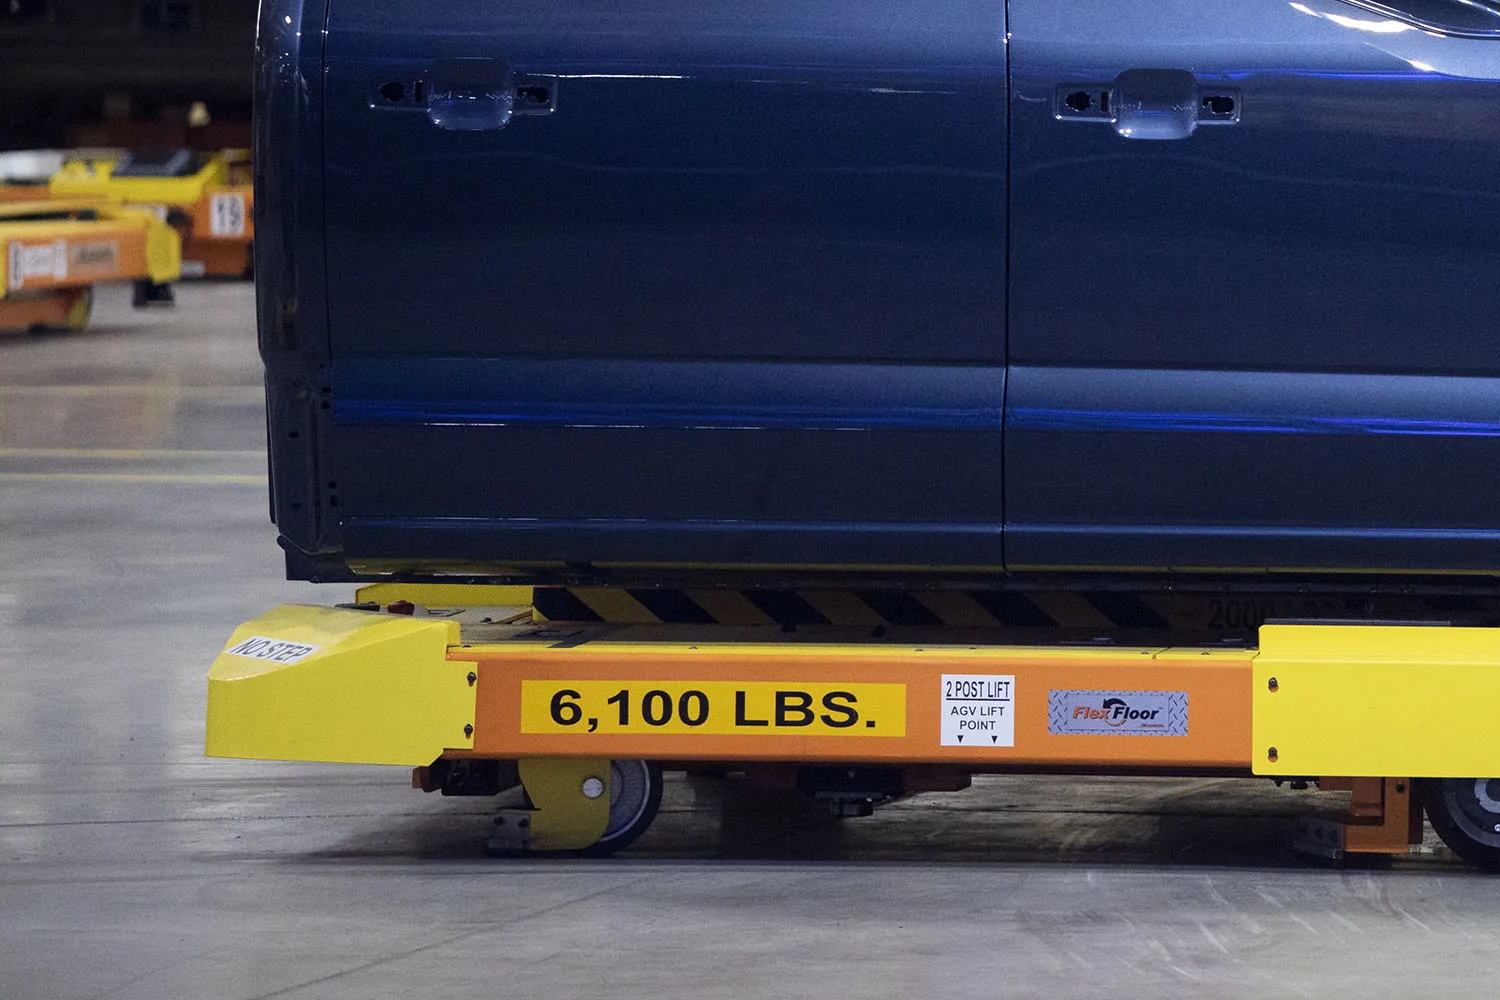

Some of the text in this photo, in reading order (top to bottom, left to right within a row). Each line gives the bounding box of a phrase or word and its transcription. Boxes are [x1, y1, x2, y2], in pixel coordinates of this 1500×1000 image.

[230, 638, 313, 662] NO STEP
[946, 680, 1011, 698] 2 POST LIFT
[549, 689, 876, 733] 6,100 LBS.
[950, 705, 1005, 717] AGV LIFT
[960, 720, 996, 730] POINT
